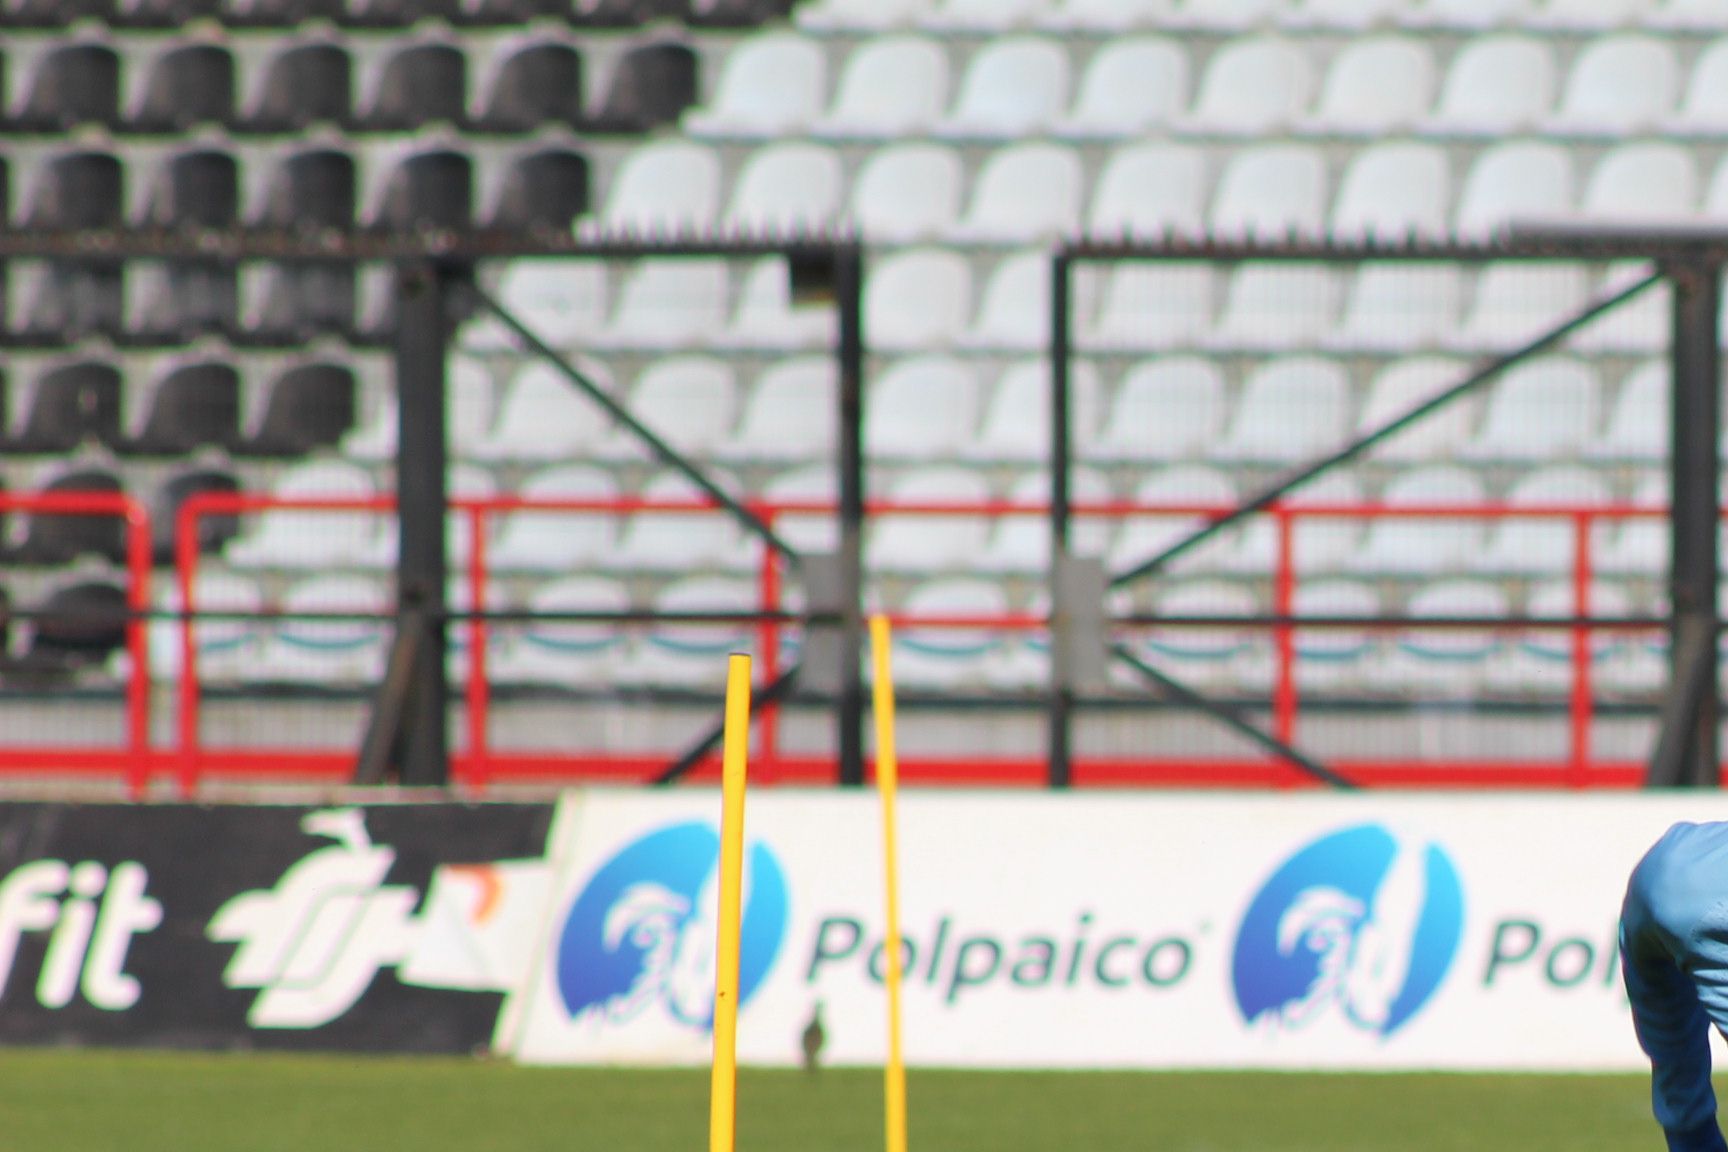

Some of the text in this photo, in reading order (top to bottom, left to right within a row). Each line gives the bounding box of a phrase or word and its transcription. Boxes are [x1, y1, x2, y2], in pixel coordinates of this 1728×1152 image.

[0, 859, 164, 1010] fit
[804, 913, 1194, 1004] Polpaico
[1482, 917, 1630, 1008] Pol
